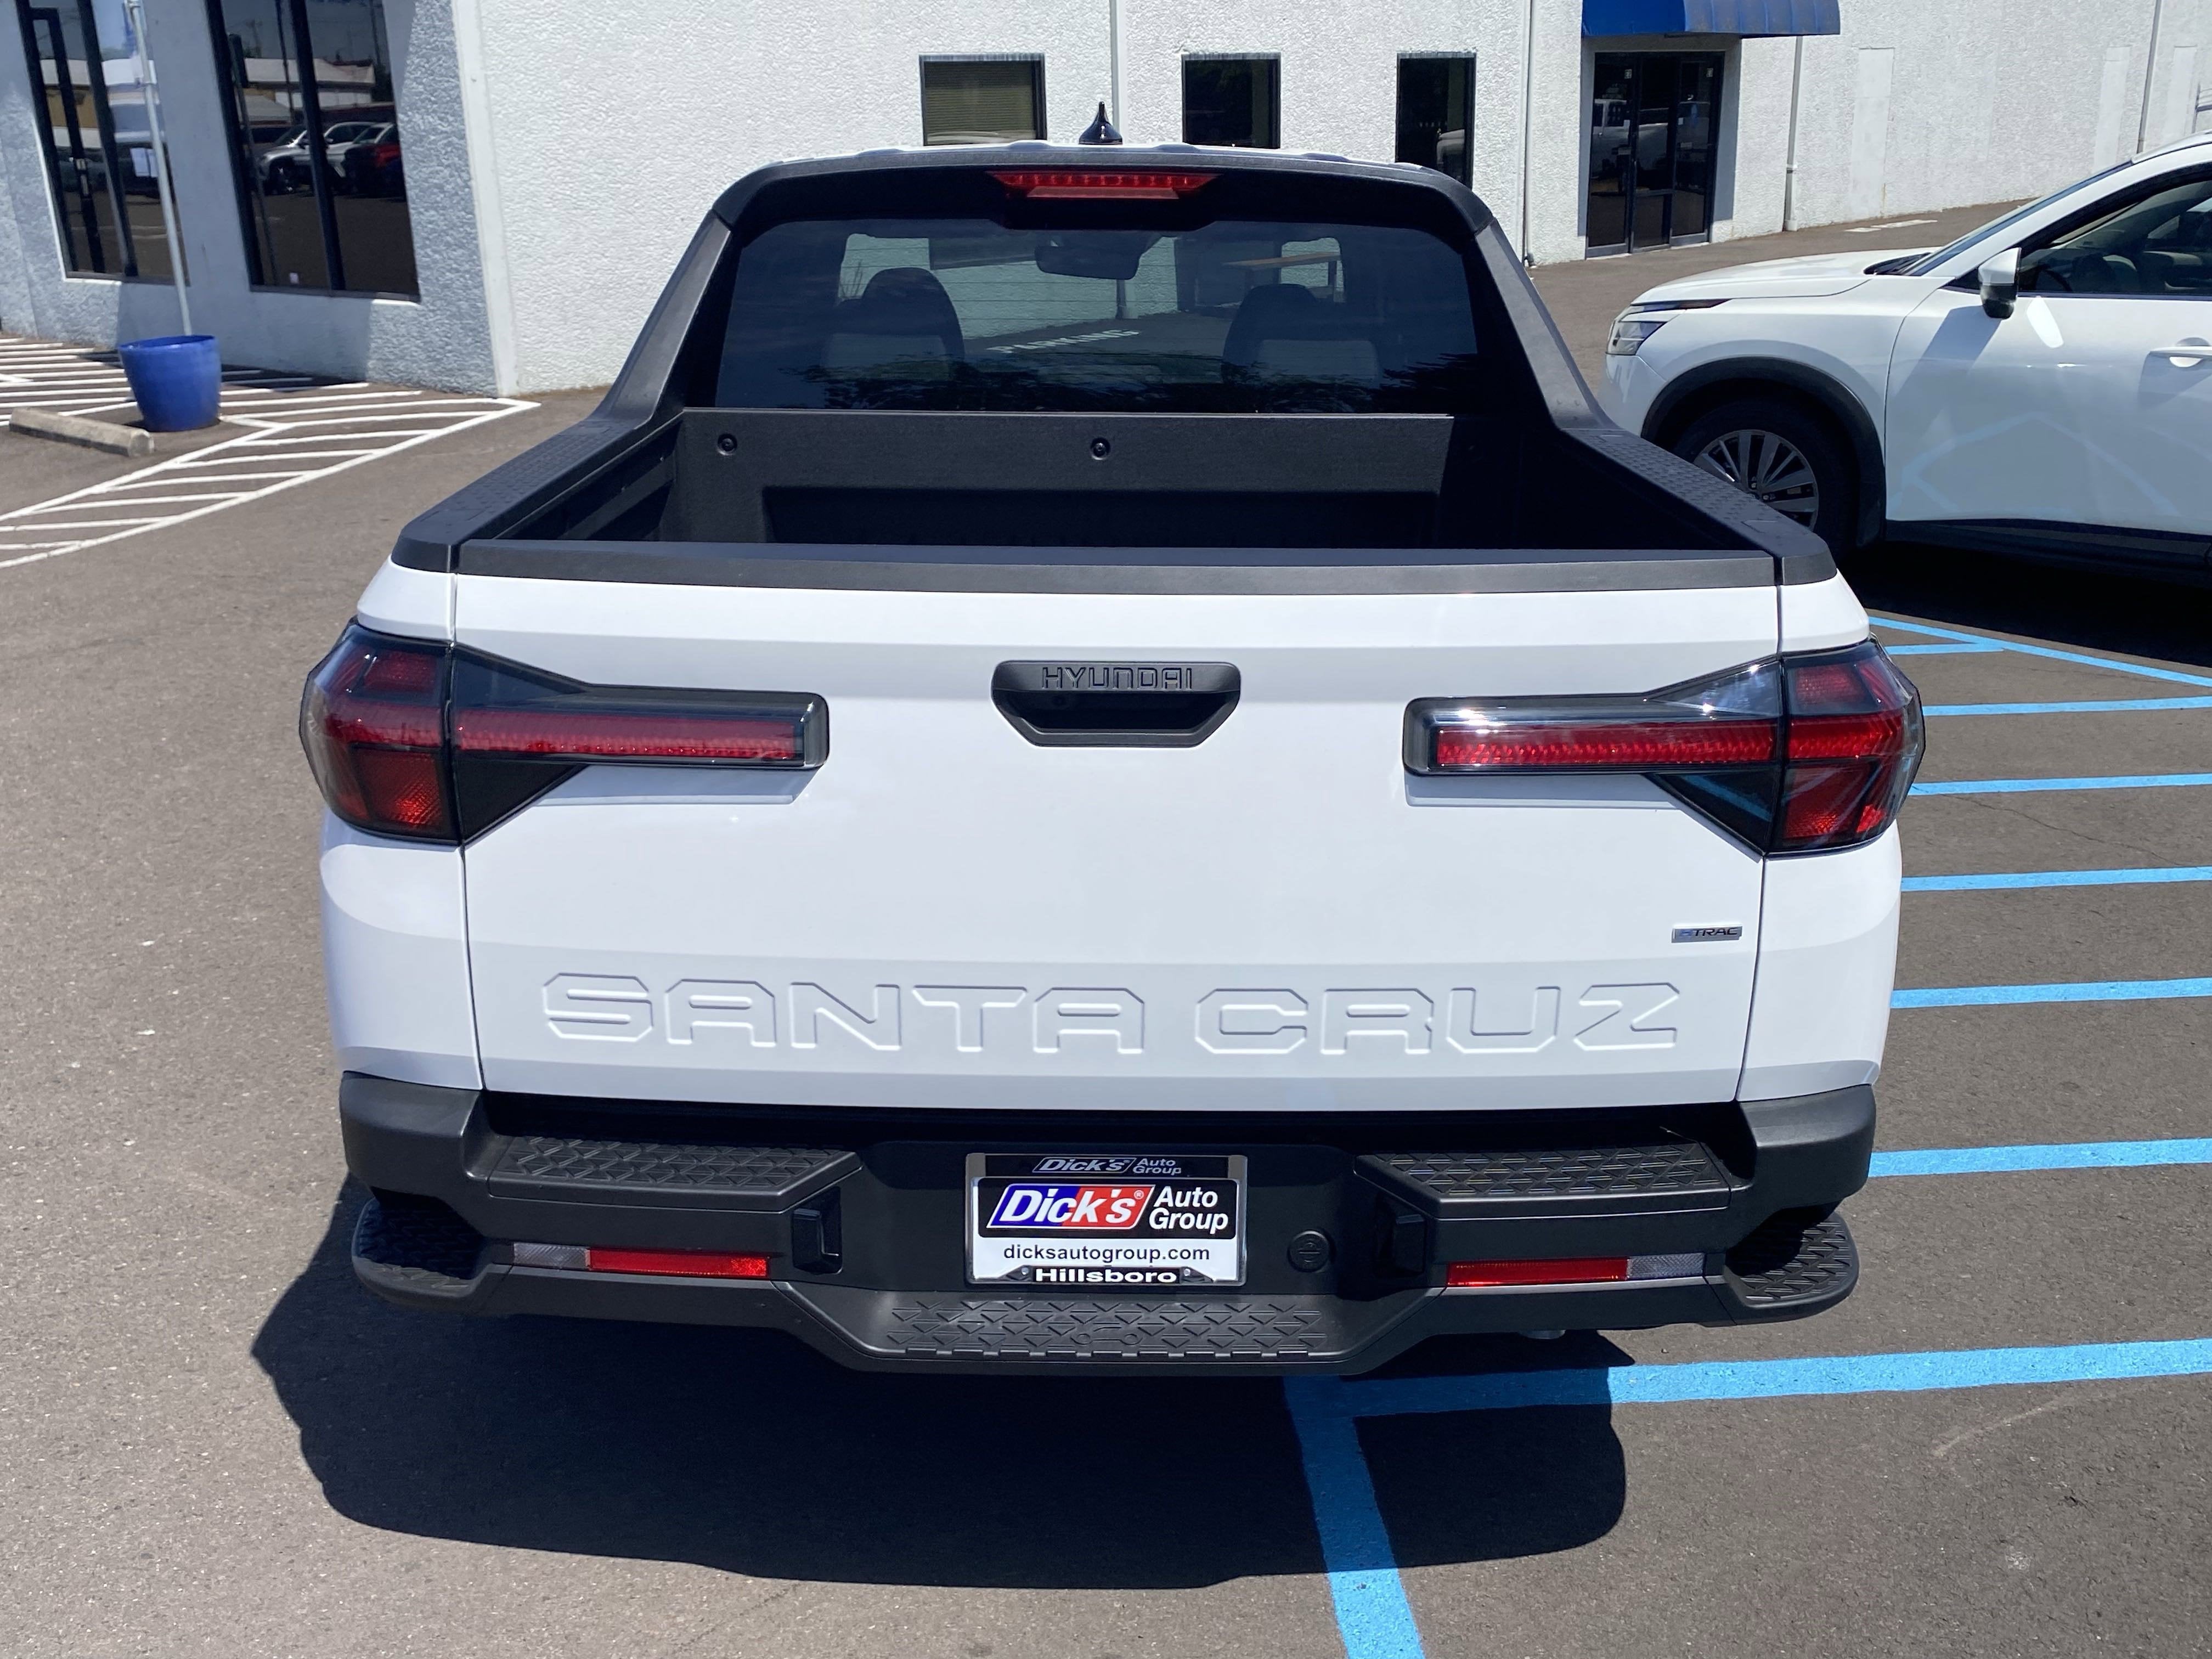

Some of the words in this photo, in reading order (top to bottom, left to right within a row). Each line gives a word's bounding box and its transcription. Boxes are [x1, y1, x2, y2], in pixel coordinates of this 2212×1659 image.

[1042, 666, 1193, 690] HYUNDAI
[542, 972, 1146, 1053] SANTA
[1194, 982, 1680, 1056] CRUZ
[1039, 1158, 1126, 1171] Dick's
[1137, 1158, 1176, 1166] Auto
[1132, 1166, 1182, 1175] Group
[999, 1188, 1136, 1223] Dick's
[1154, 1186, 1218, 1208] Auto
[1149, 1207, 1229, 1234] Group
[1003, 1244, 1210, 1263] dicksautogroup.com
[1036, 1268, 1177, 1283] Hillsboro
